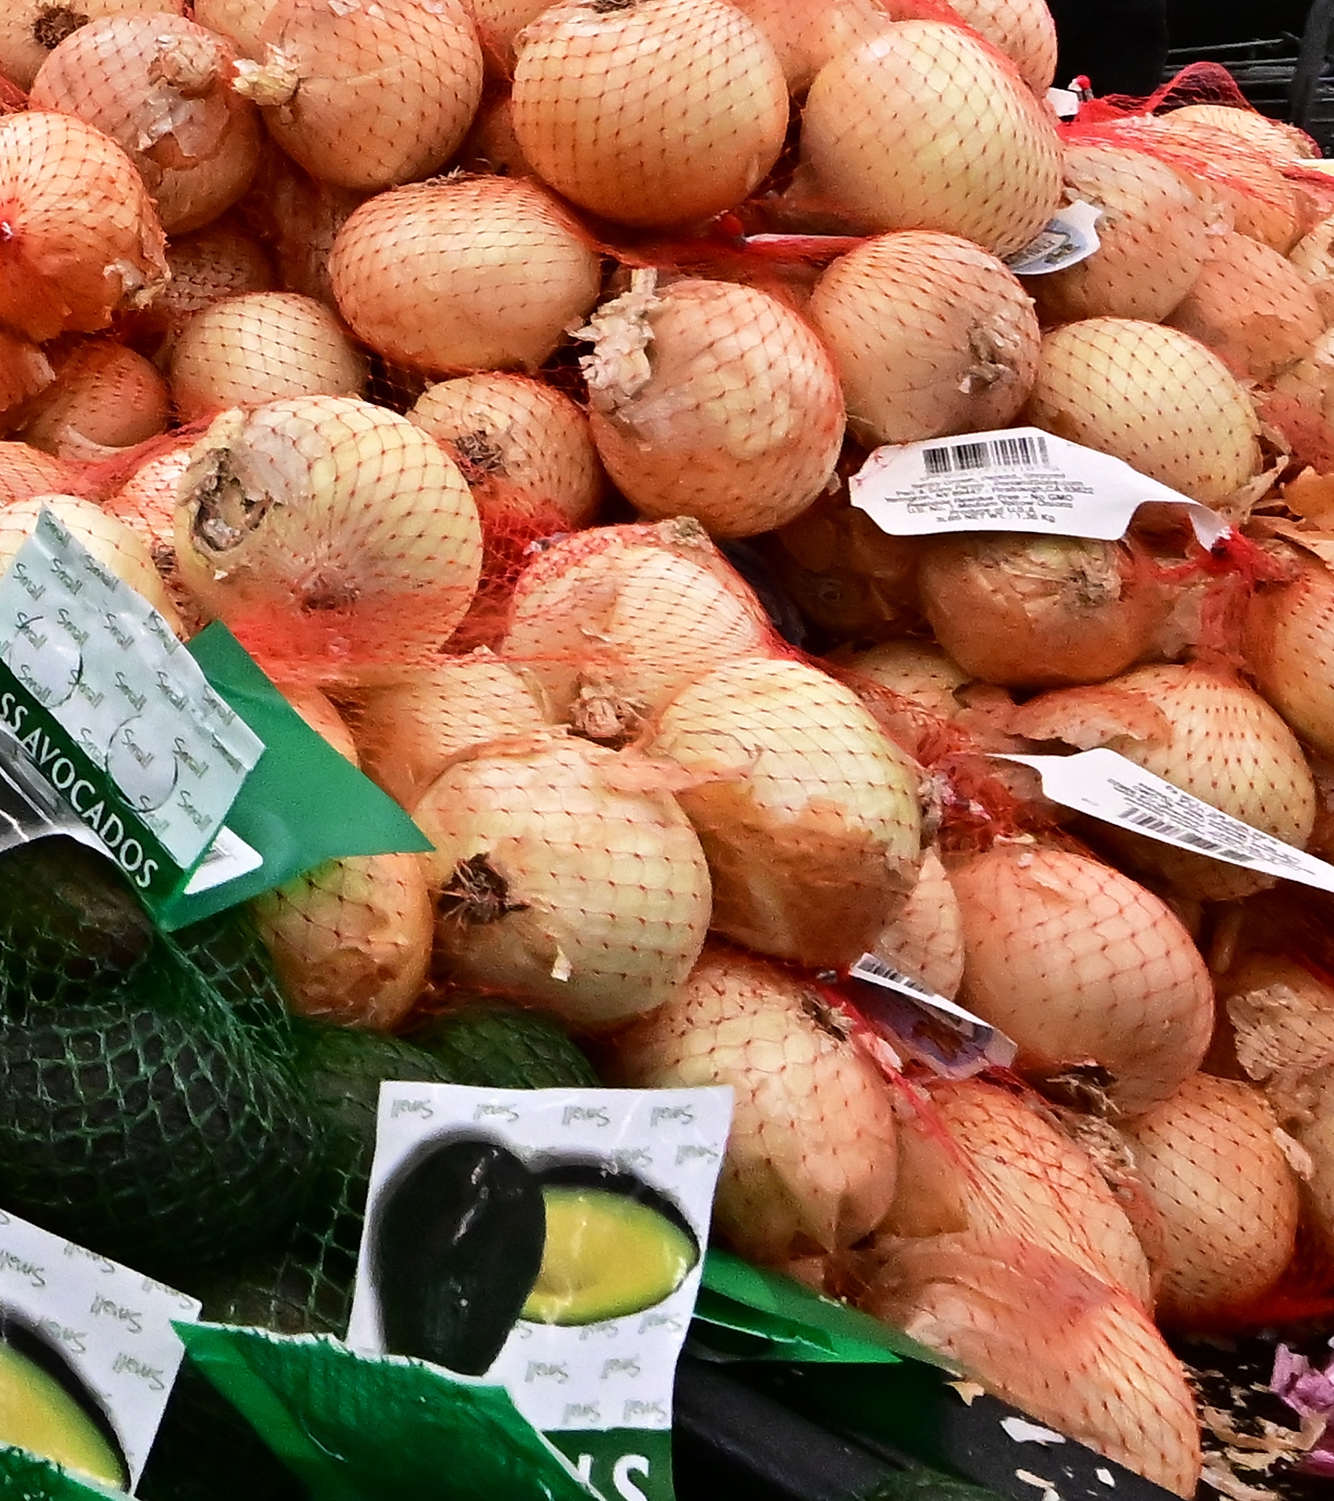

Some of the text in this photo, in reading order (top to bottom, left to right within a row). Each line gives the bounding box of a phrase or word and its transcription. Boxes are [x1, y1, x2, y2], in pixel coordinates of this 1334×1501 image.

[1047, 493, 1073, 501] GMO
[13, 563, 43, 601] Small
[51, 559, 83, 594] Small
[57, 608, 88, 645] Small
[103, 613, 134, 647] Small
[73, 671, 103, 707] Small
[114, 671, 146, 714] Small
[154, 671, 187, 709] Small
[119, 727, 152, 769] Small
[21, 723, 160, 890] AVOCADOS
[177, 790, 212, 832] Small
[391, 1097, 433, 1122] Small
[473, 1101, 520, 1125] Small
[563, 1102, 611, 1128] Small
[91, 1292, 143, 1333] Small
